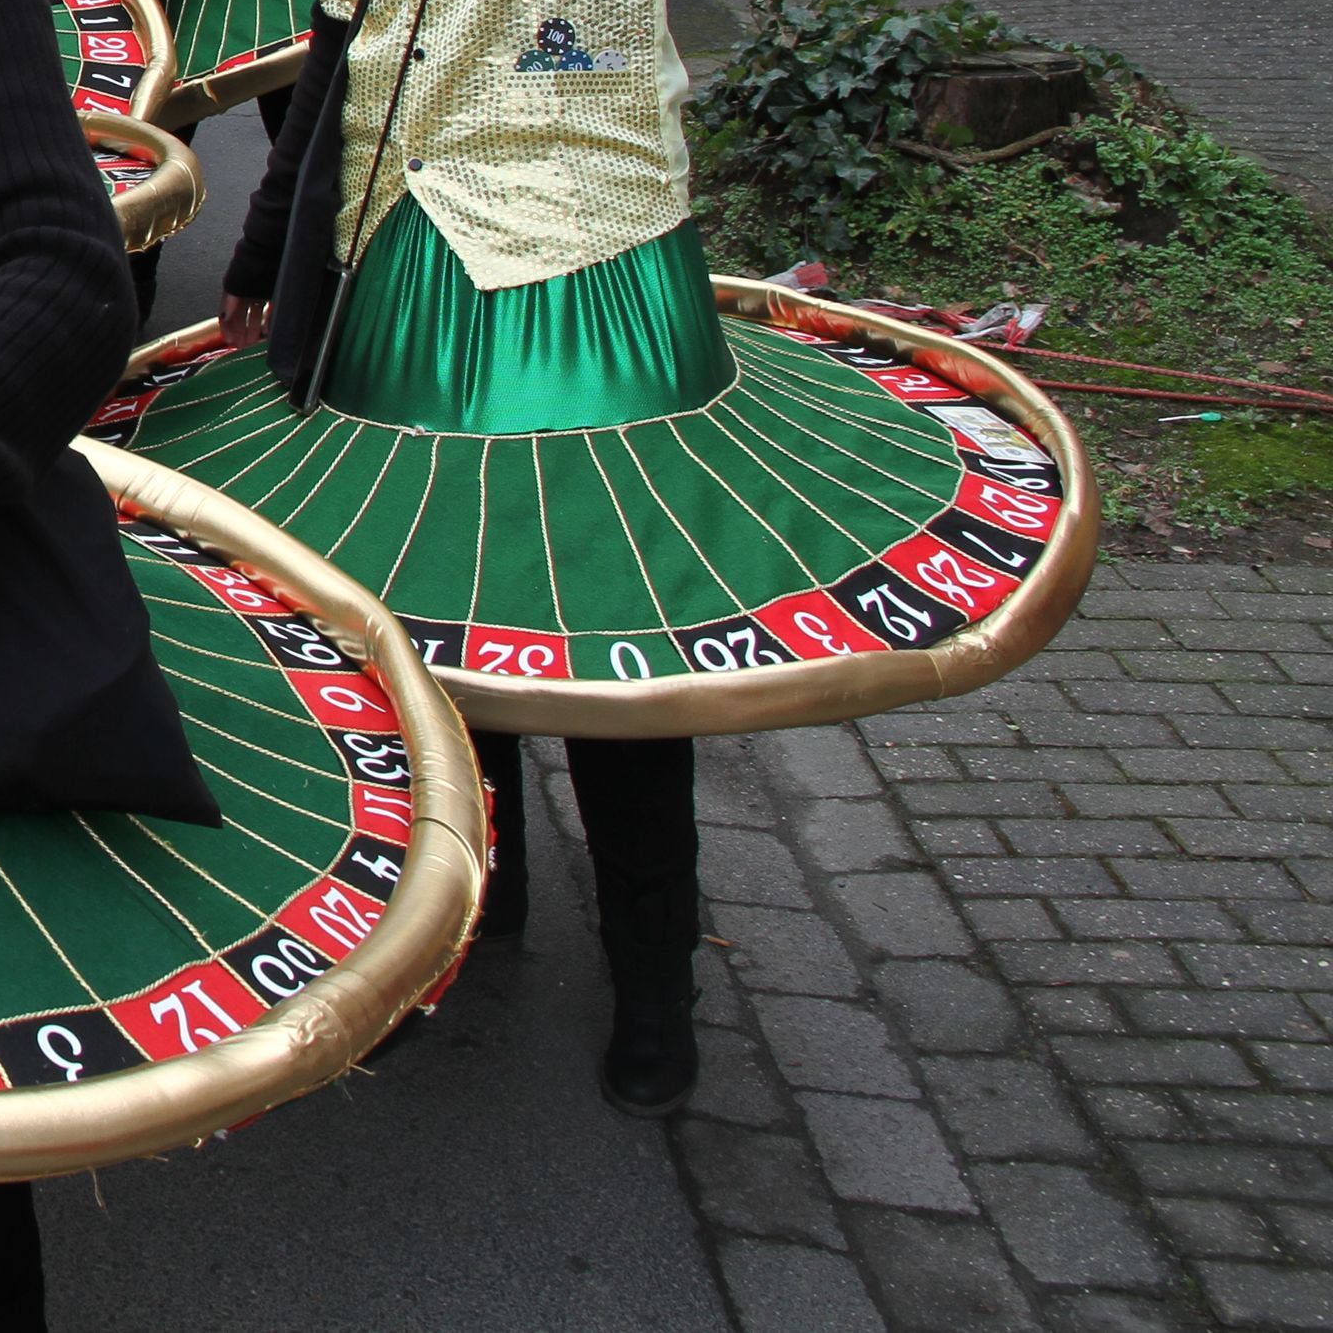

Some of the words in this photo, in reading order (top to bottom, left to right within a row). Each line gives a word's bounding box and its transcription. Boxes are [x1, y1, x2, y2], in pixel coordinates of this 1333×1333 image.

[80, 16, 118, 25] 1
[546, 29, 564, 44] 100
[87, 35, 128, 61] 20
[91, 73, 132, 88] 7
[879, 373, 950, 393] 31
[978, 458, 1049, 490] 18
[978, 484, 1047, 529] 29
[137, 531, 198, 563] 11
[960, 529, 1027, 569] 7
[198, 565, 261, 608] 36
[916, 550, 998, 609] 28
[855, 582, 933, 642] 12
[258, 618, 343, 666] 29
[692, 627, 783, 668] 26
[793, 610, 853, 656] 3
[477, 641, 555, 677] 32
[609, 641, 653, 680] 0
[319, 685, 387, 714] 6
[342, 732, 411, 783] 33
[350, 850, 401, 881] 4
[309, 885, 381, 951] 20
[150, 978, 244, 1050] 12
[37, 1024, 84, 1081] 3
